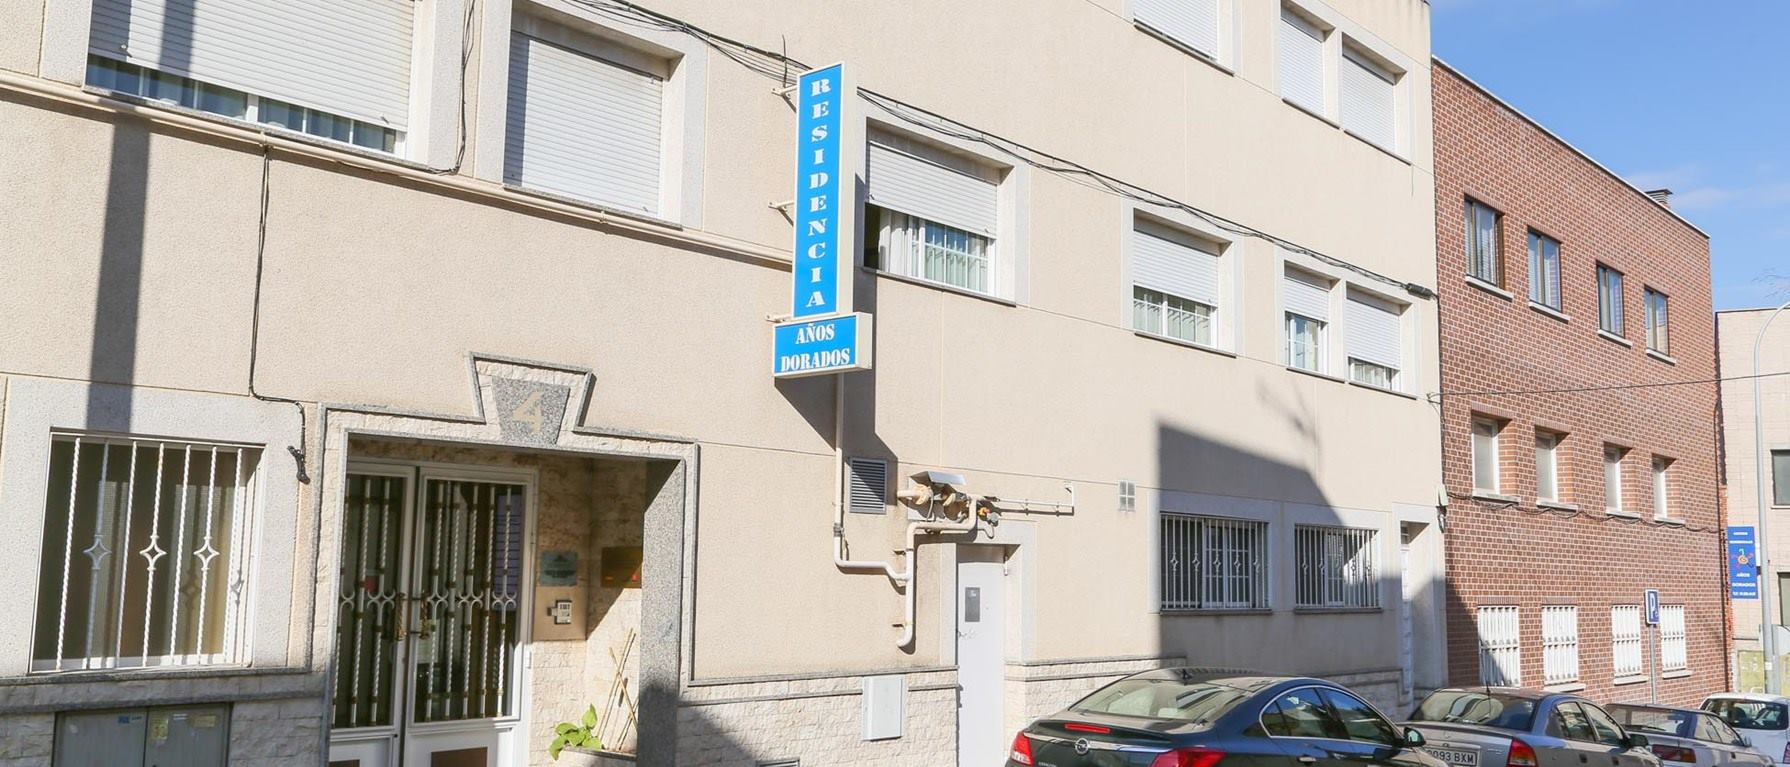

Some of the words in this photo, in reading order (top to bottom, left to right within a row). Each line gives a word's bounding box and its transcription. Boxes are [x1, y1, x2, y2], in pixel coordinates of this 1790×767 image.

[806, 78, 831, 308] RESIDENCIA
[795, 323, 835, 344] AÑOS
[780, 347, 850, 372] DORADOS
[512, 391, 544, 433] 4
[1649, 593, 1656, 619] P
[1454, 752, 1474, 763] BXM
